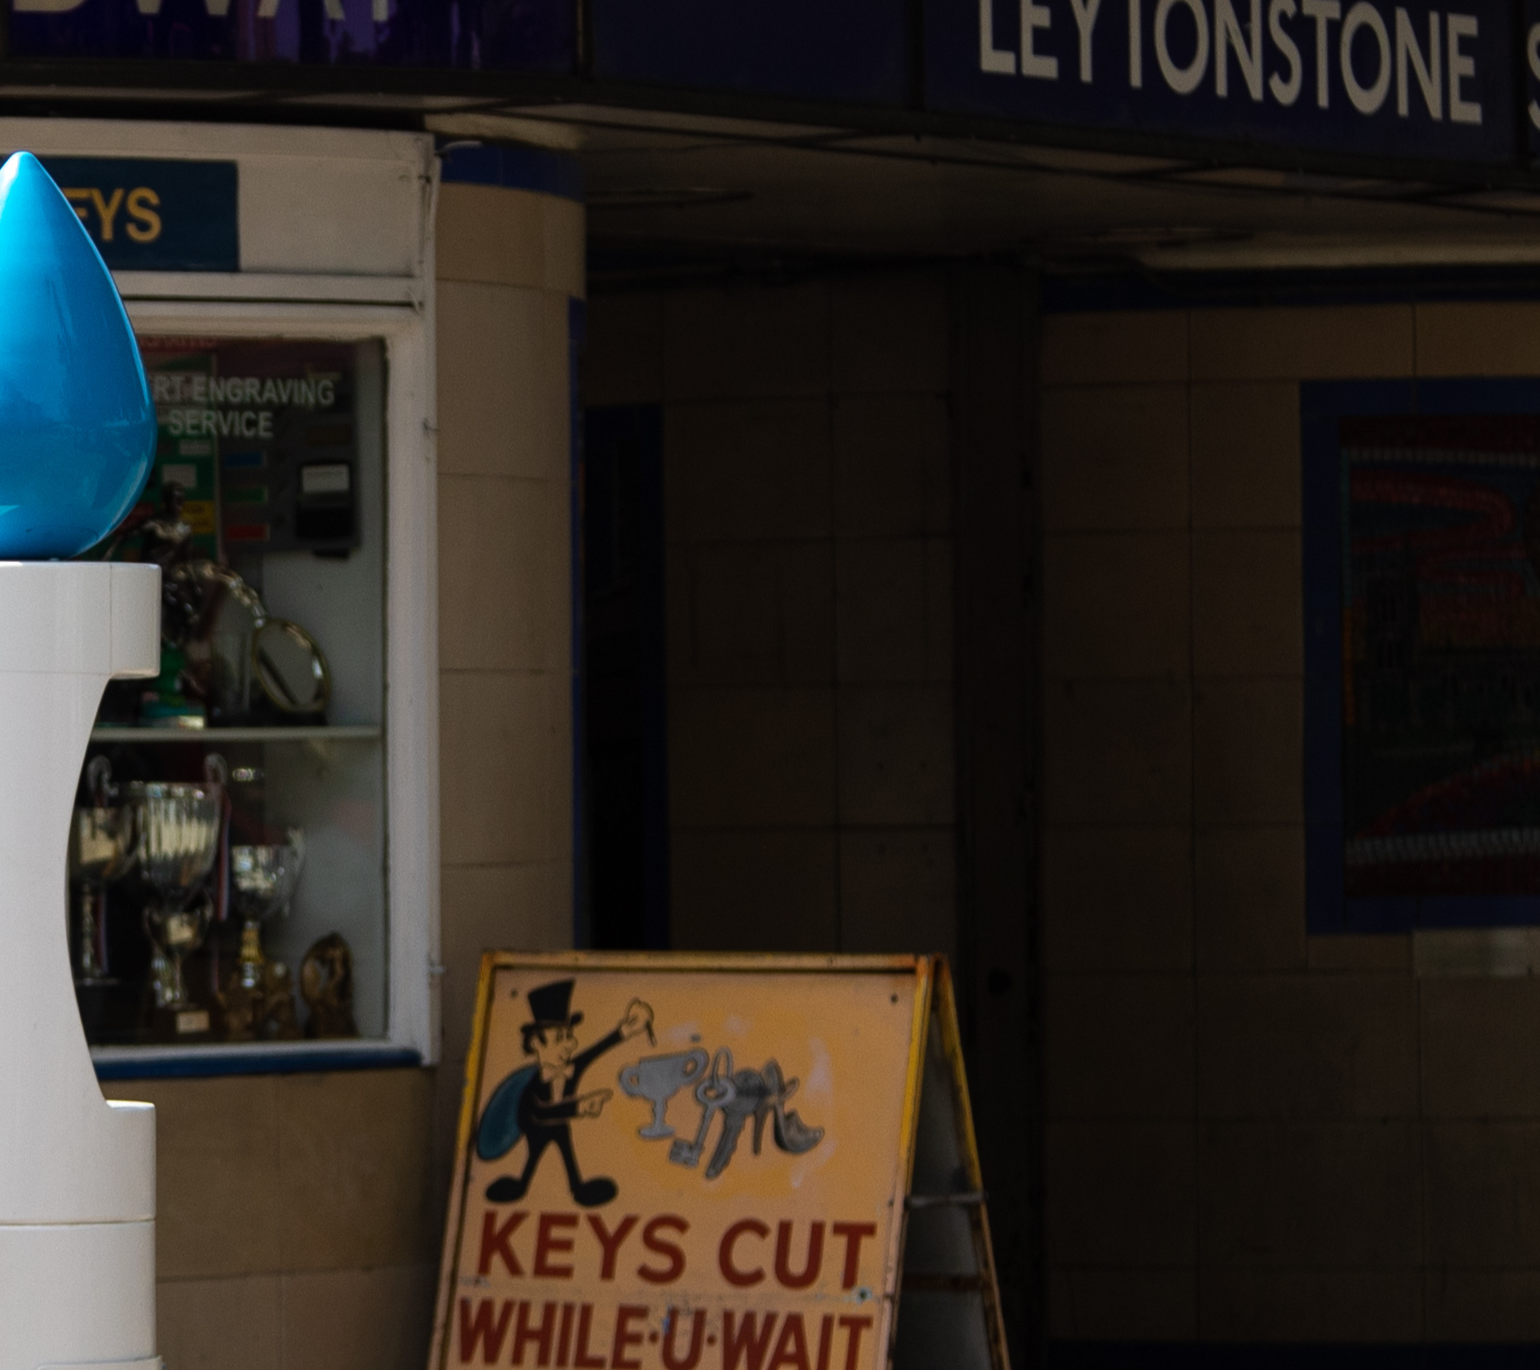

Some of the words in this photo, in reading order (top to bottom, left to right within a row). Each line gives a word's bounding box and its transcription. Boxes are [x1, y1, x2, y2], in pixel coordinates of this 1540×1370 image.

[191, 377, 335, 406] ENGRAVING
[168, 410, 274, 438] SERVICE
[477, 1210, 690, 1285] KEYS
[718, 1217, 877, 1290] CUT
